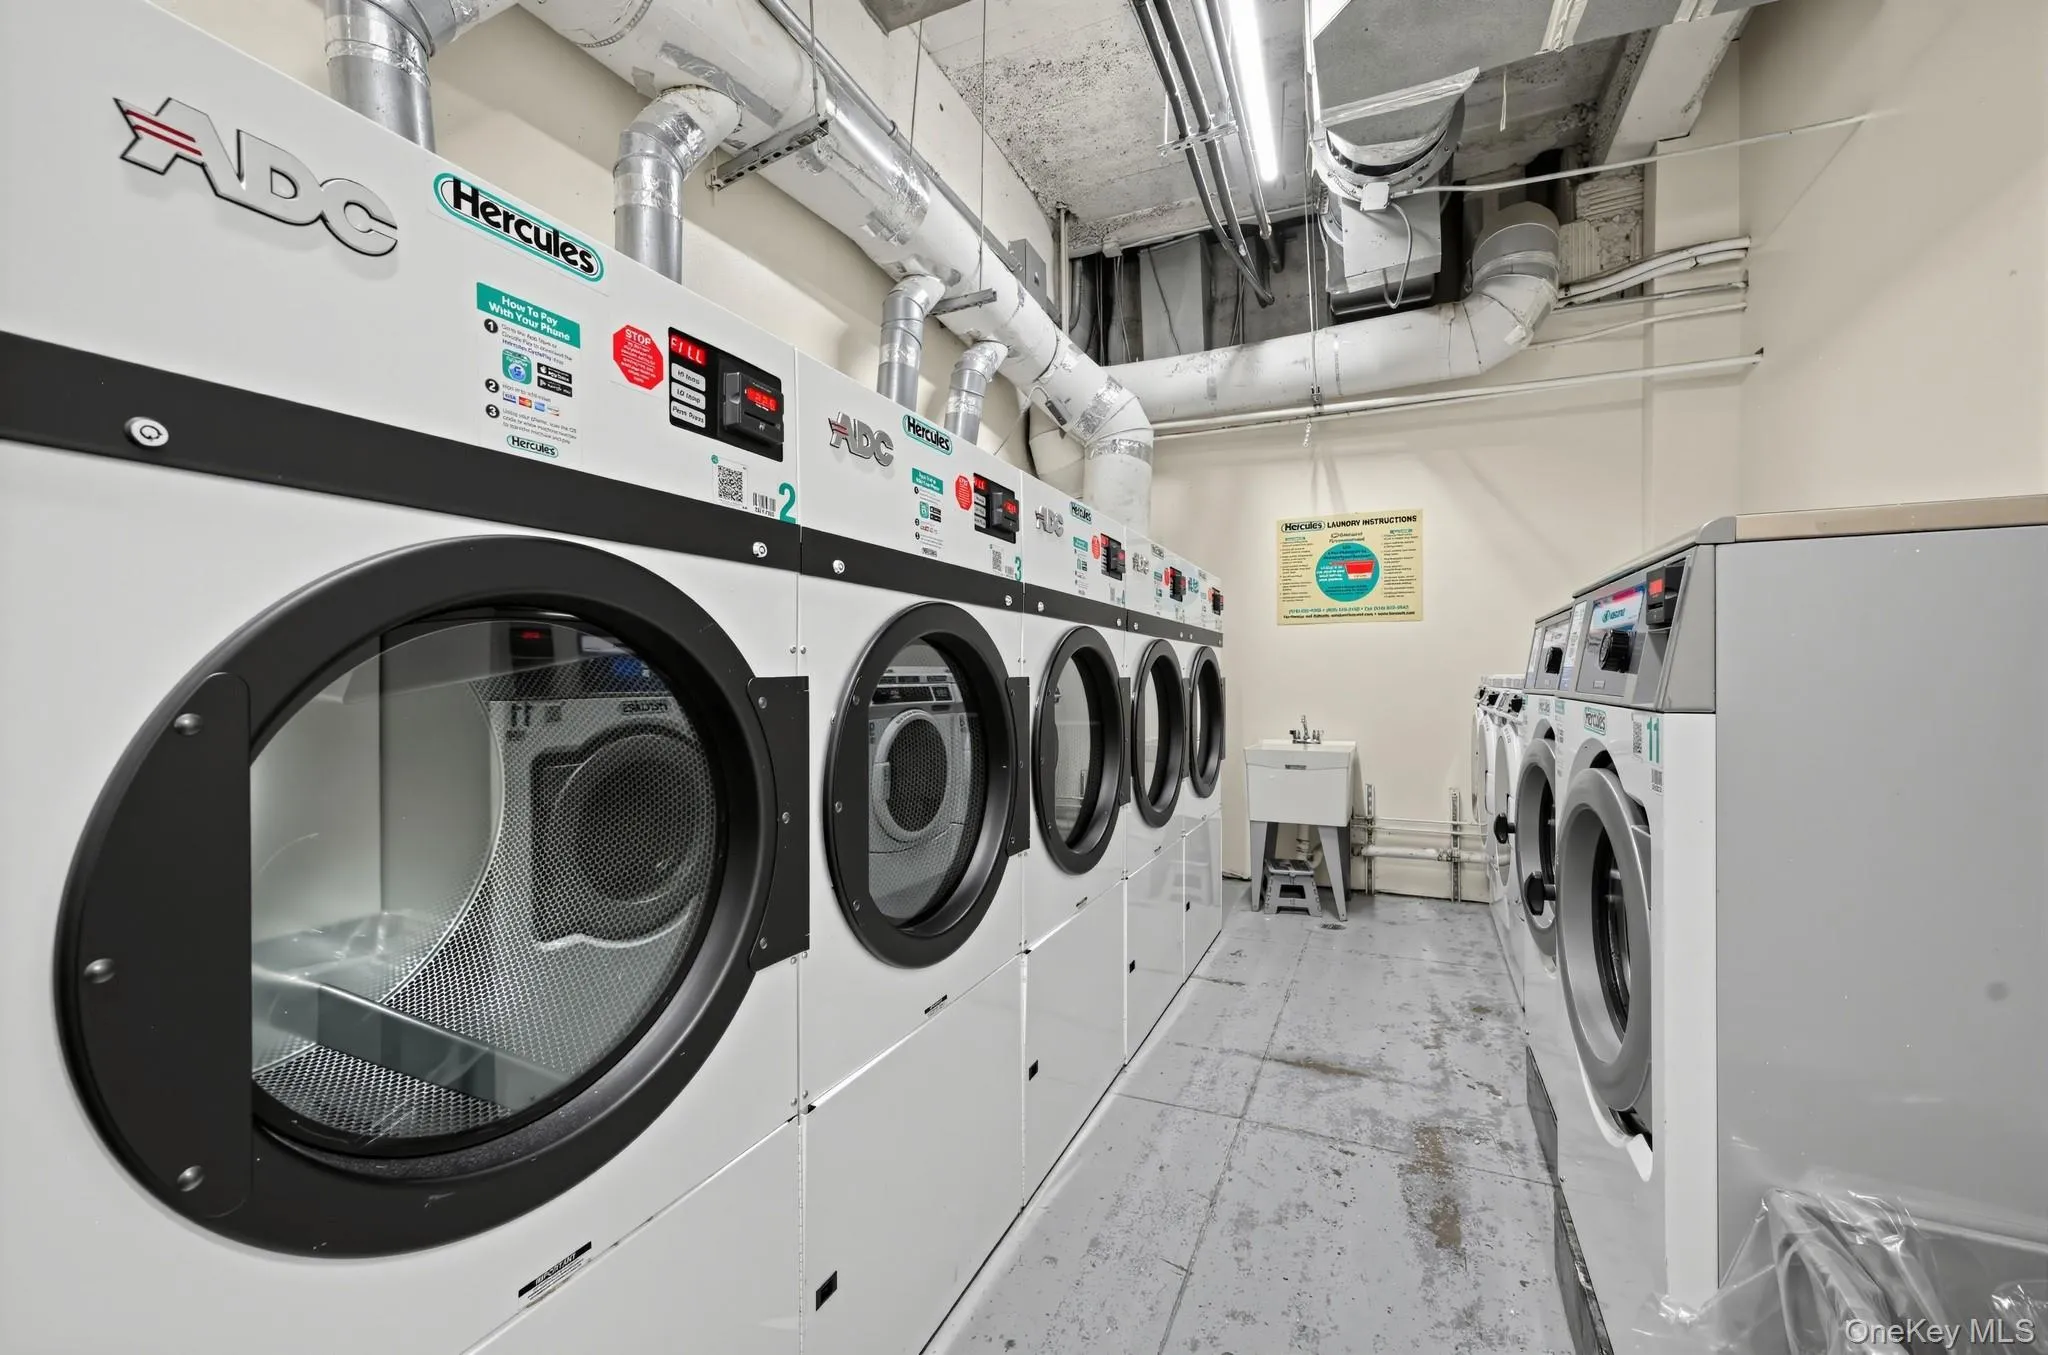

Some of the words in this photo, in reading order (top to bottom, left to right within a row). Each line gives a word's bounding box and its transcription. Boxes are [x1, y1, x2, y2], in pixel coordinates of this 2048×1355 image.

[112, 97, 398, 257] ADC
[453, 177, 594, 274] Hercules
[488, 301, 514, 320] With
[515, 312, 539, 329] Your
[541, 323, 571, 342] Phone
[502, 296, 526, 313] How
[527, 306, 539, 318] To
[541, 312, 559, 327] Pay
[625, 328, 652, 346] STOP
[671, 336, 703, 364] FILL
[511, 435, 556, 456] Hercules
[828, 411, 894, 467] ADC
[907, 415, 950, 451] Hercules
[779, 482, 796, 524] 2
[1035, 505, 1064, 538] ADC
[1284, 521, 1323, 532] Hercules
[1327, 519, 1360, 529] LAUNDRY
[1362, 515, 1417, 526] INSTRUCTIONS
[1014, 556, 1022, 581] 3
[1646, 716, 1660, 764] 11
